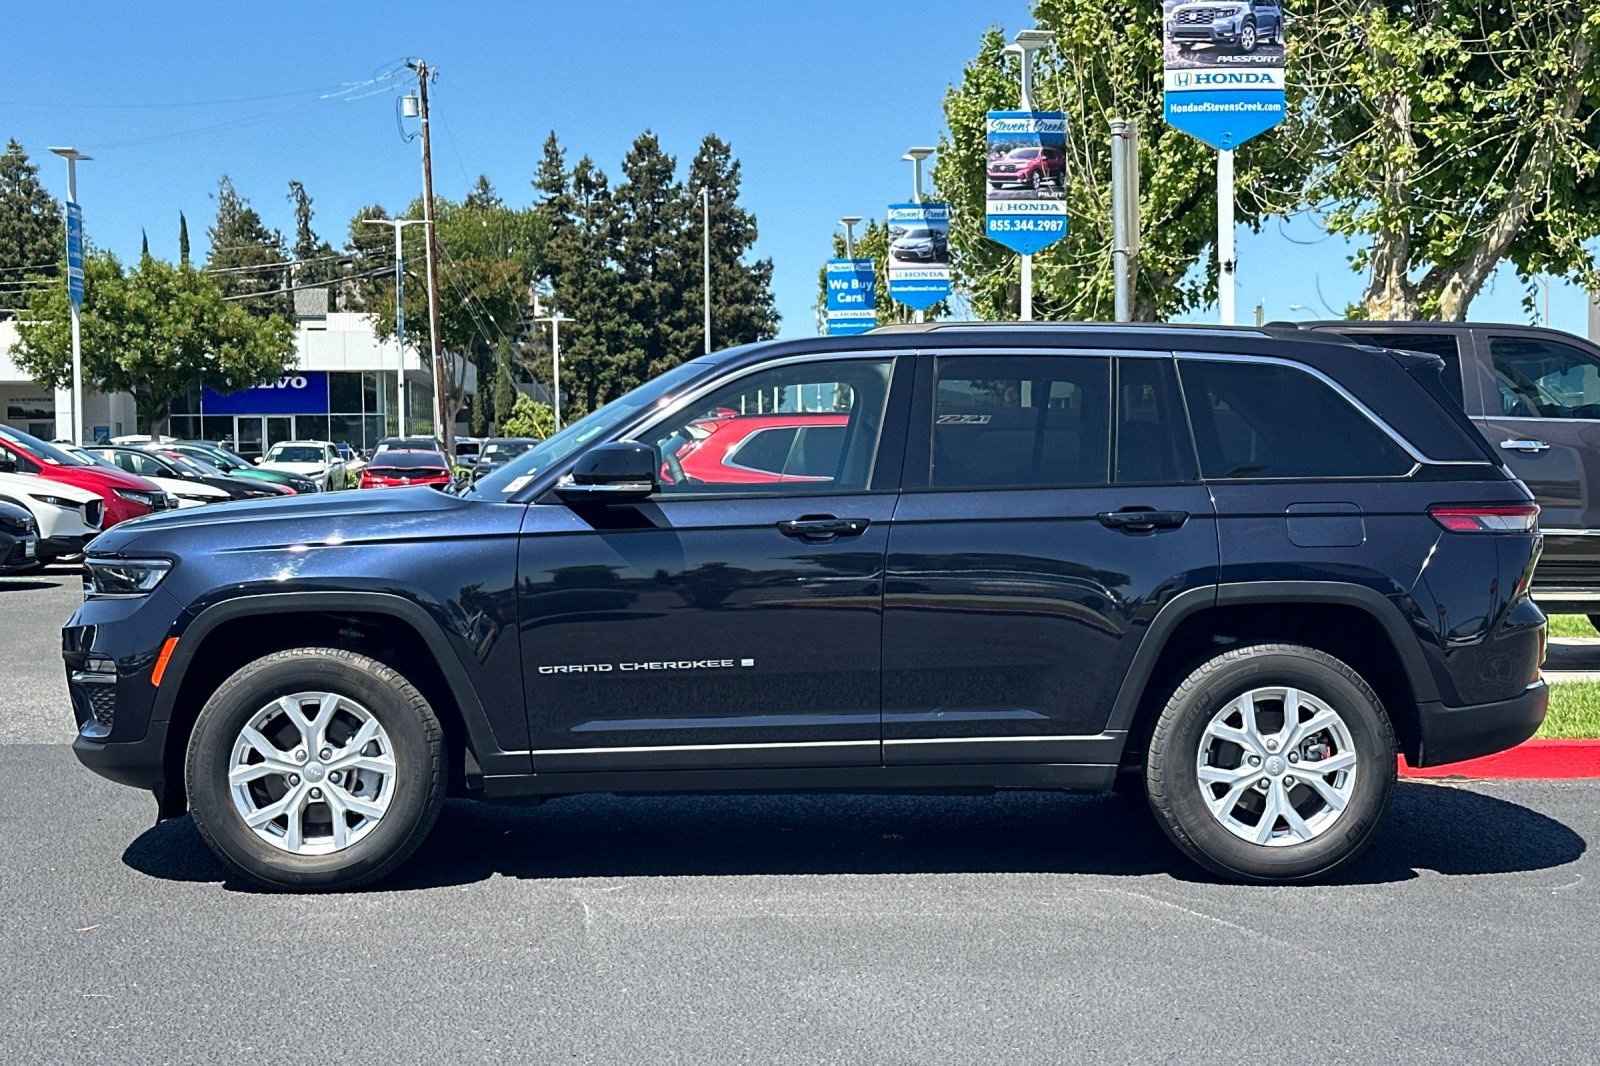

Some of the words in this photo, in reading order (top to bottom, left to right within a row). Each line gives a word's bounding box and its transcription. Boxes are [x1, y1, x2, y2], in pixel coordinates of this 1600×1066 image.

[1216, 55, 1280, 63] PASSPORT
[1194, 73, 1276, 84] HONDA
[1169, 101, 1281, 113] HondaofStevensCreek.com
[990, 119, 1031, 133] Stevens
[1034, 119, 1065, 132] Creek
[1007, 203, 1060, 212] HONDA
[989, 219, 1064, 232] 855.344.2987
[829, 279, 848, 290] We
[851, 278, 873, 292] Buy
[837, 292, 866, 303] Cars!
[248, 376, 308, 389] LVO
[538, 664, 613, 674] GRAND
[619, 659, 735, 671] CHEROKEE
